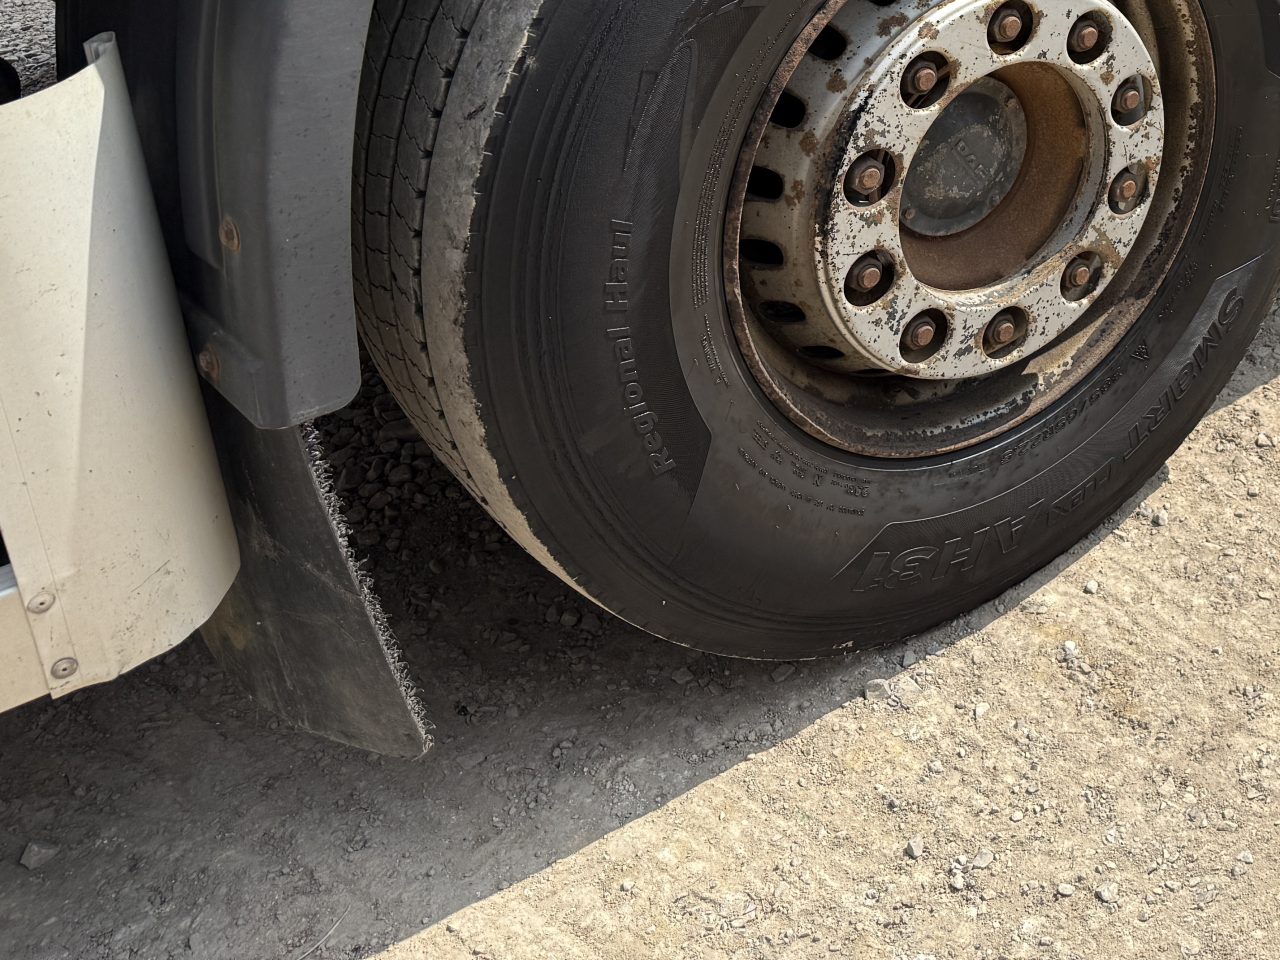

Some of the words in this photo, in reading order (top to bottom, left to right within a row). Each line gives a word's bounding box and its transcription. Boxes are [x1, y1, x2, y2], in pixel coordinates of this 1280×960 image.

[952, 138, 988, 178] DAF
[603, 217, 633, 313] Haul
[605, 325, 678, 476] Regional
